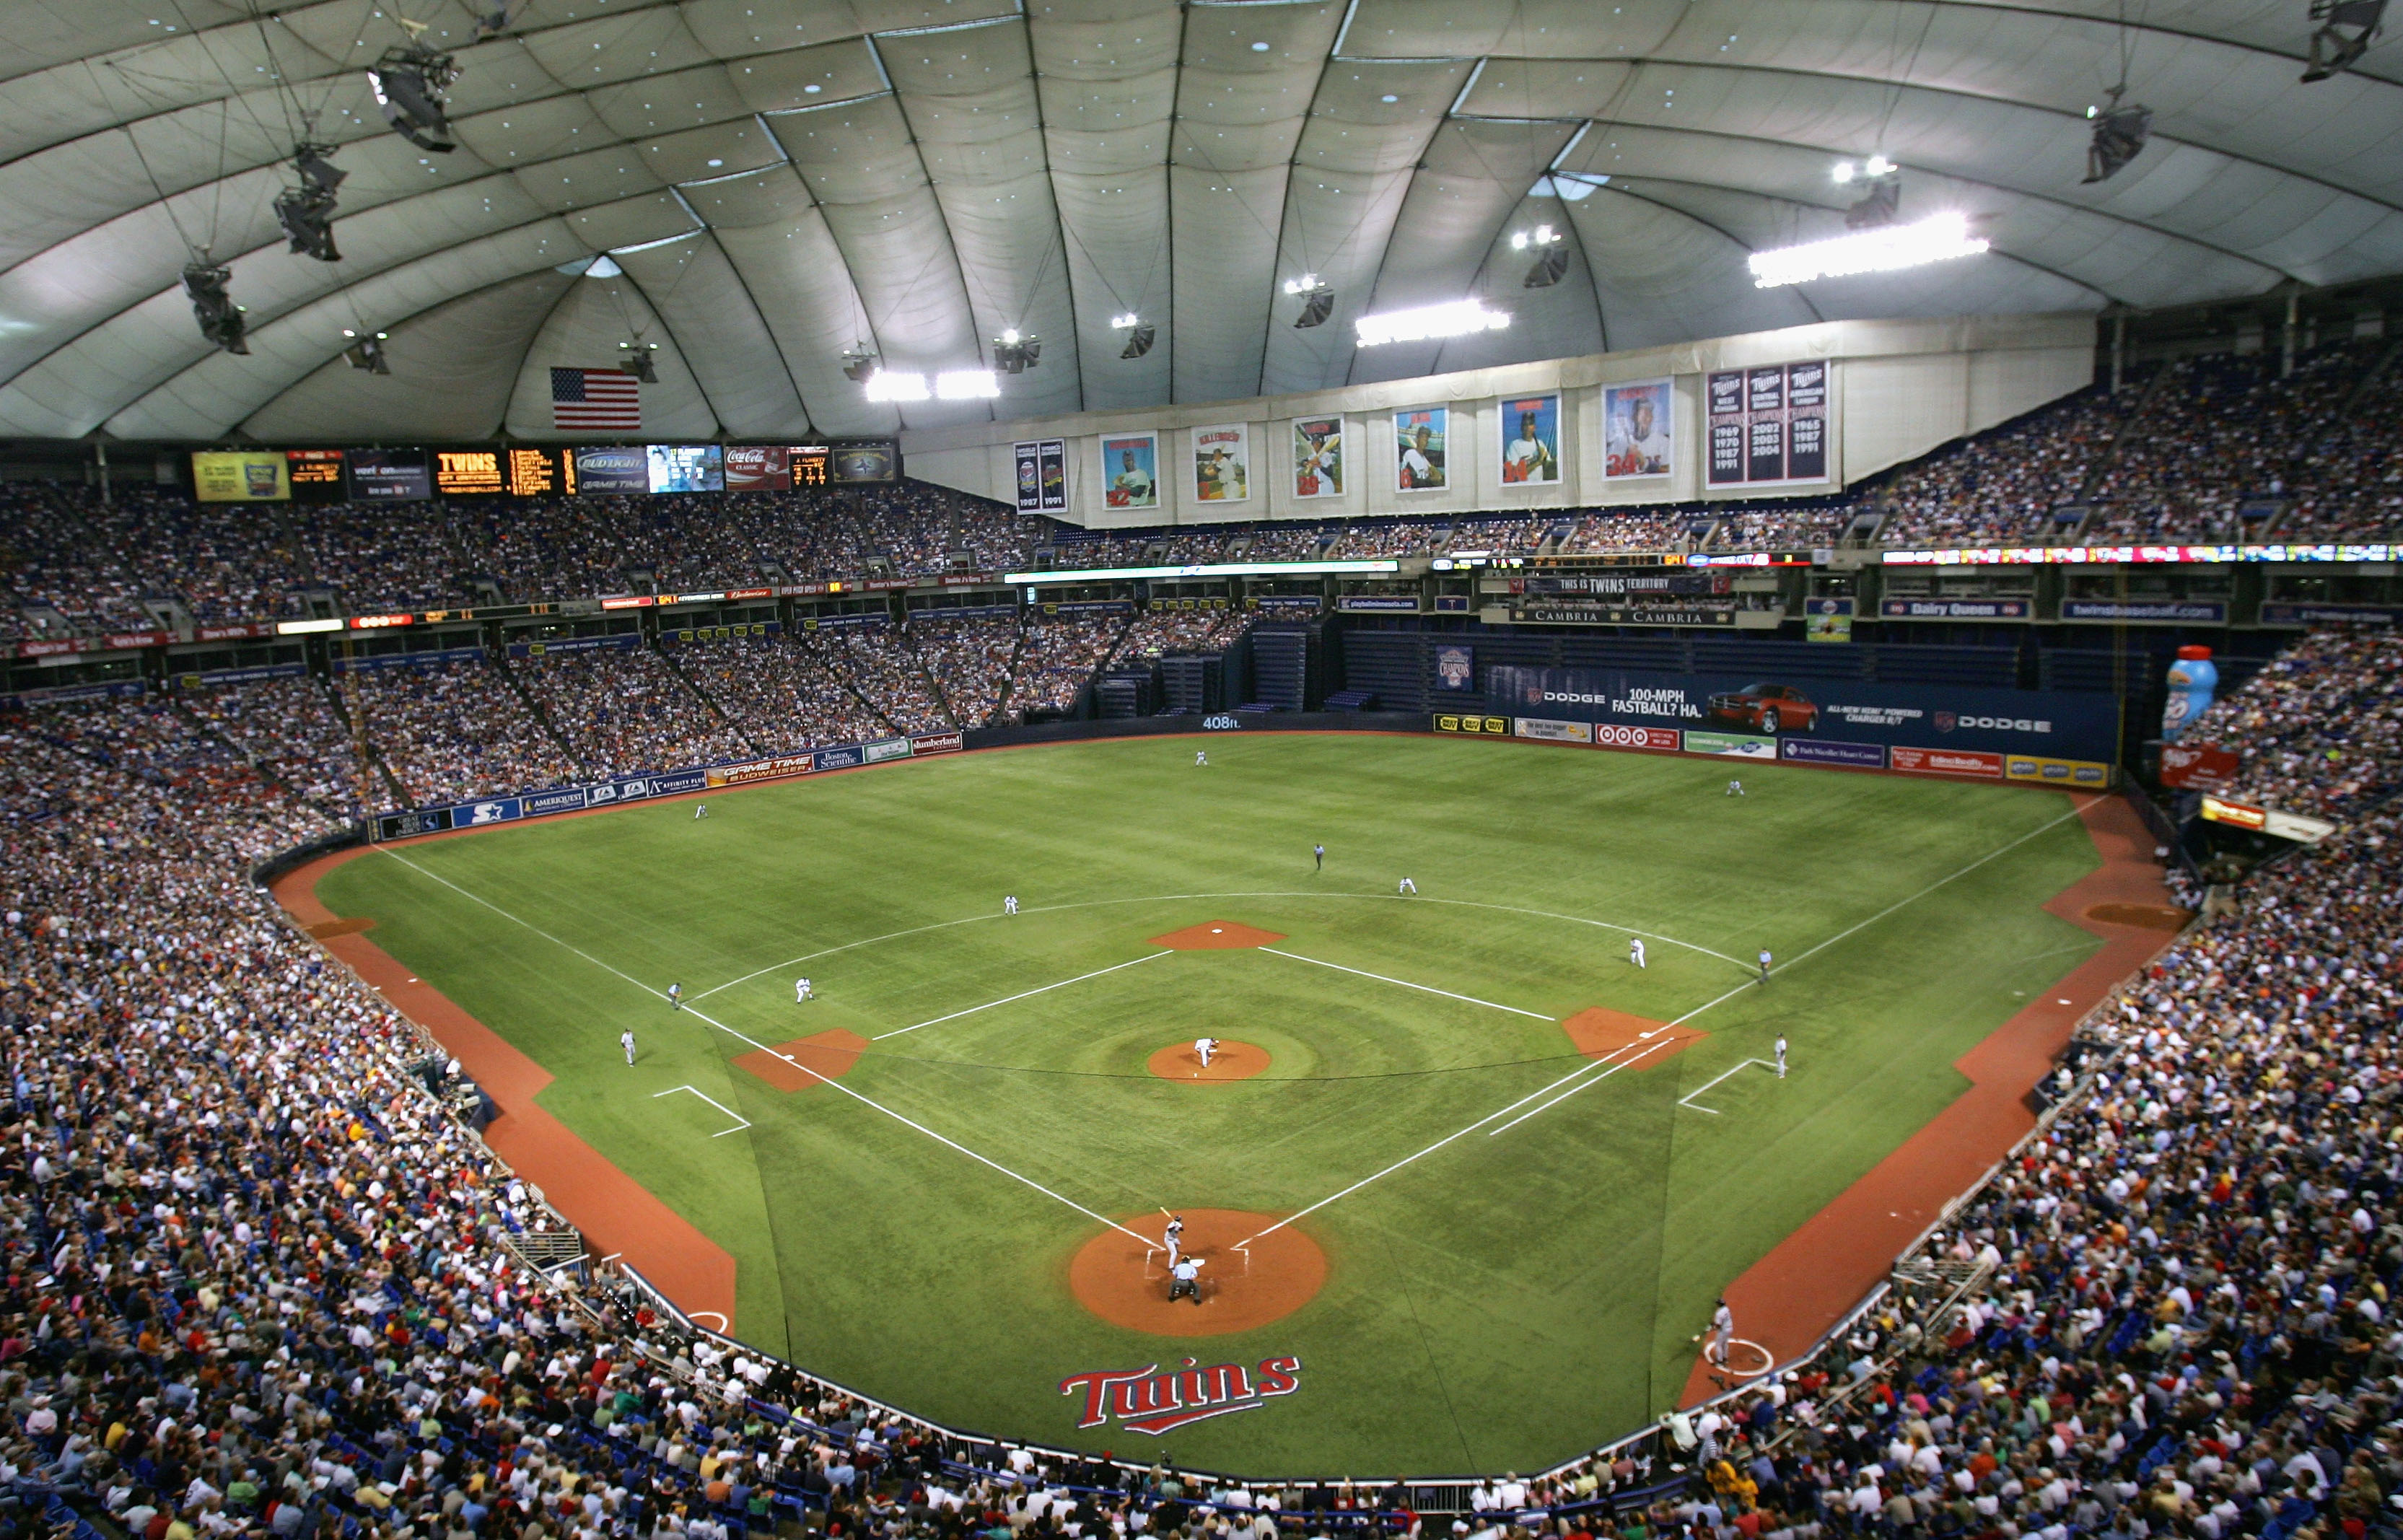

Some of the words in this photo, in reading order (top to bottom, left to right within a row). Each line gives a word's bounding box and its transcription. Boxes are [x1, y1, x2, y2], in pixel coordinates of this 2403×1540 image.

[1751, 423, 1780, 434] 2002
[1751, 445, 1780, 457] 2004
[438, 453, 497, 471] TWINS
[582, 458, 608, 468] BUD
[609, 458, 642, 468] LIGHT
[1607, 454, 1636, 476] 34
[1504, 459, 1528, 482] 14
[1107, 489, 1131, 506] 42
[1198, 481, 1209, 500] 3
[1561, 579, 1577, 590] THIS
[1580, 579, 1588, 590] IS
[1590, 578, 1624, 593] TWINS
[1625, 578, 1669, 590] TERRITORY
[1536, 611, 1598, 621] CAMBRIA
[1912, 602, 1948, 616] Dairy
[1950, 603, 1996, 616] Queen
[1633, 612, 1702, 624] CAMBRIA
[1544, 691, 1606, 704] DODGE
[1629, 688, 1685, 703] 100-MPH
[1612, 699, 1676, 716] FASTBALL?
[1680, 704, 1702, 718] HA.
[1204, 716, 1241, 730] 408ft.
[1958, 715, 2052, 733] DODGE
[913, 735, 960, 749] slumberland
[820, 754, 857, 768] Scientific
[824, 752, 848, 761] Boston
[724, 764, 772, 776] GAME
[774, 756, 811, 769] TIME
[728, 764, 806, 782] BUDWEISER
[535, 793, 582, 807] AMERIQUEST
[1058, 1357, 1301, 1435] Twins
